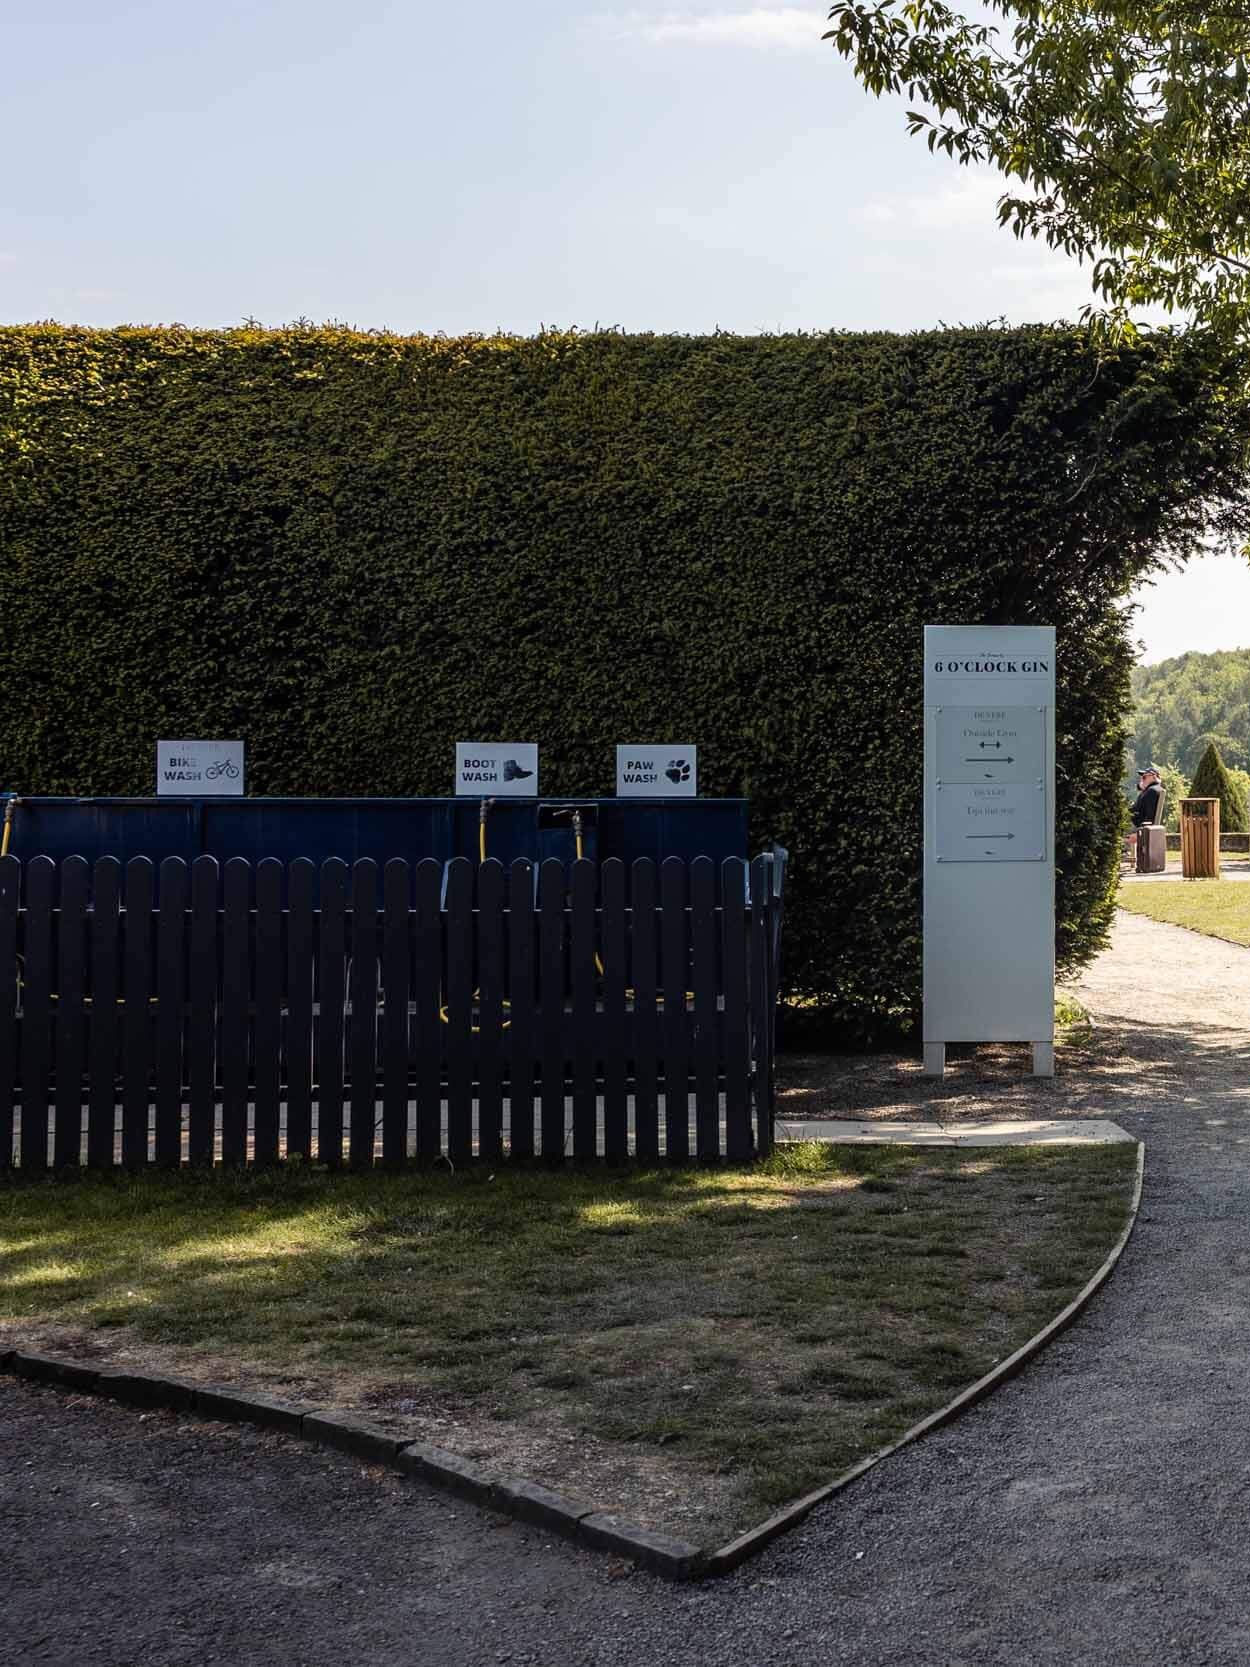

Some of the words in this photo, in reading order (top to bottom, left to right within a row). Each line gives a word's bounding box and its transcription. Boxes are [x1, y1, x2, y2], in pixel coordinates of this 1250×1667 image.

[934, 661, 943, 673] 6
[947, 661, 1017, 673] O'CLOCK
[1021, 661, 1049, 673] GIN
[169, 757, 197, 767] BIKE
[464, 759, 497, 769] BOOT
[627, 760, 654, 770] PAW
[163, 771, 201, 781] WASH
[462, 772, 498, 782] WASH
[623, 774, 658, 784] WASH
